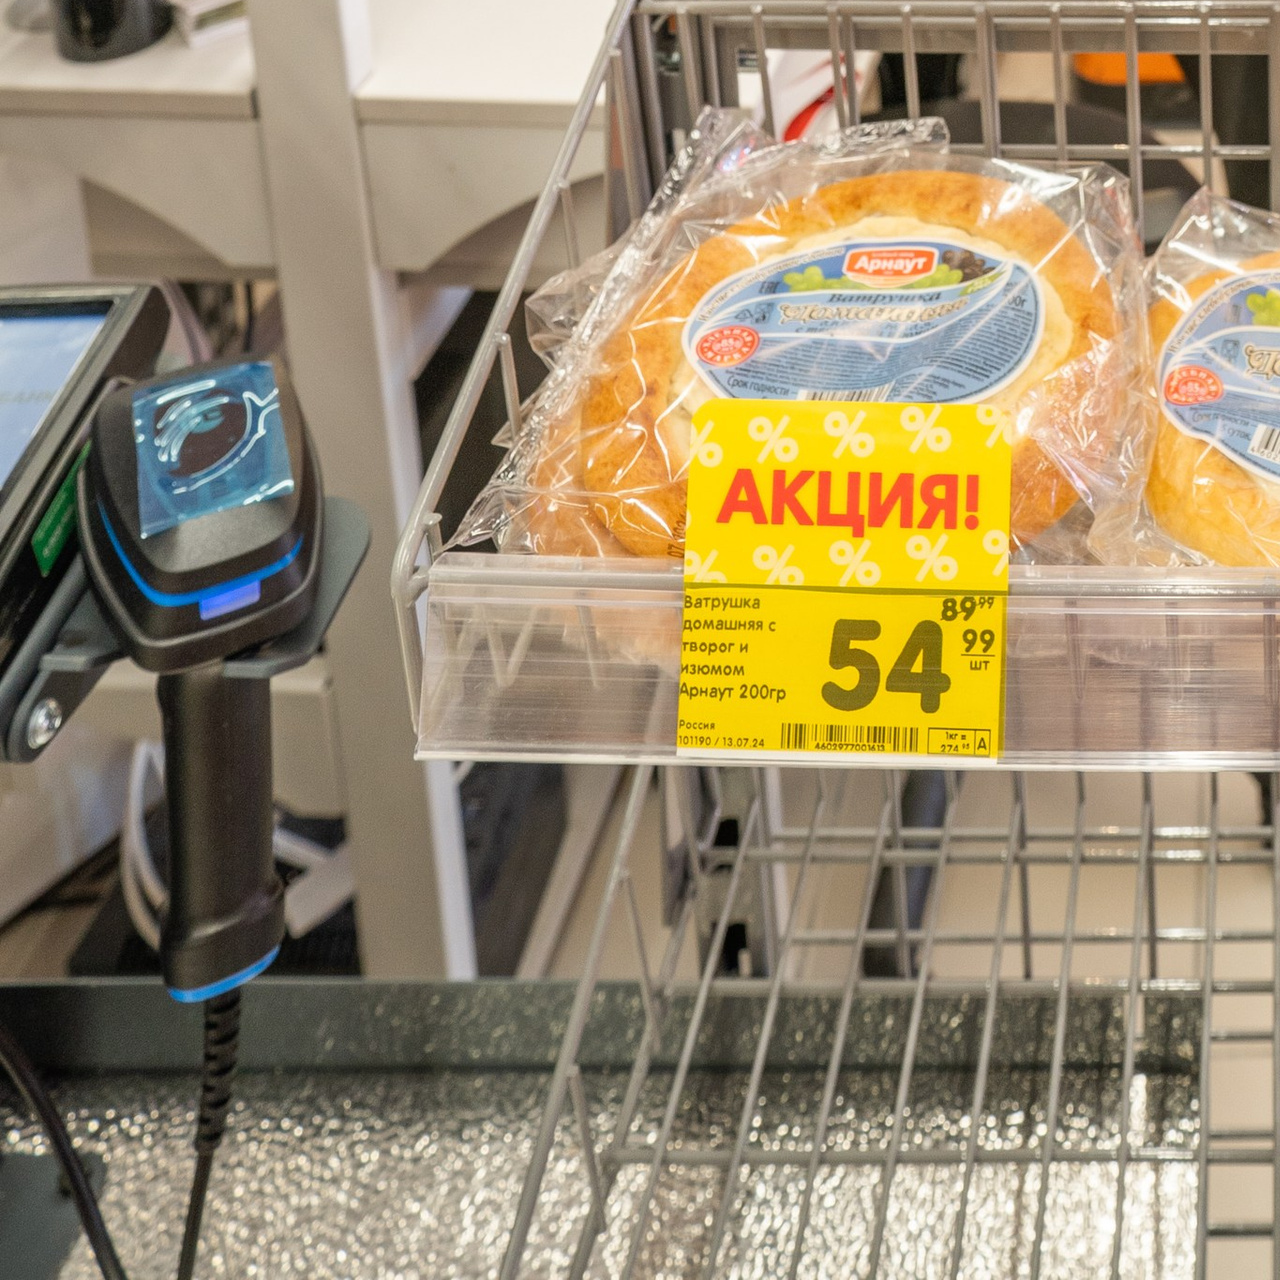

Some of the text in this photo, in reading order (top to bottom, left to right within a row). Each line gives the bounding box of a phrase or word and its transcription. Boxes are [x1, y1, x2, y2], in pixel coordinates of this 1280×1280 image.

[854, 255, 927, 275] Арнаут
[828, 292, 942, 305] Ватрушка
[715, 468, 981, 538] АКЦИЯ!
[684, 595, 761, 611] Ватрушка
[940, 596, 996, 622] 89 99
[683, 618, 777, 634] домашняя с
[682, 641, 750, 658] творог и
[961, 628, 997, 655] 99
[680, 663, 746, 677] изюмом
[821, 618, 952, 715] 54
[969, 659, 991, 671] шт
[679, 684, 788, 703] Арнаут 200гр
[678, 720, 717, 732] Россия
[678, 736, 766, 750] 101190 13.07.24
[945, 731, 959, 742] 1кг
[814, 741, 886, 754] 4602977001613
[940, 743, 960, 755] 274
